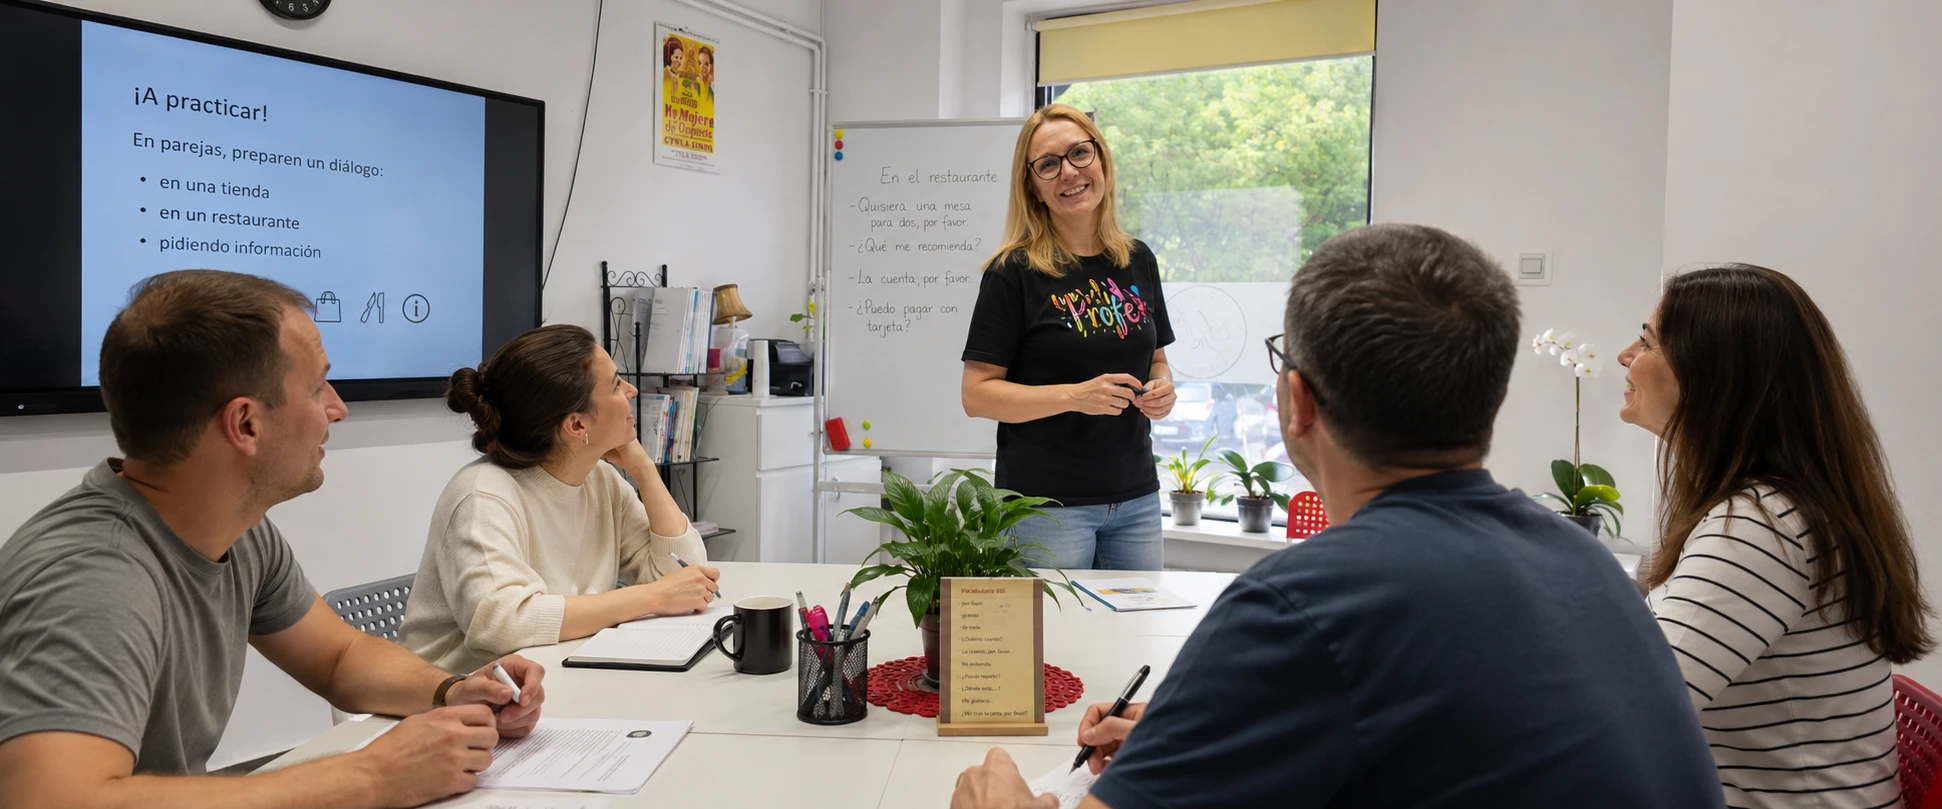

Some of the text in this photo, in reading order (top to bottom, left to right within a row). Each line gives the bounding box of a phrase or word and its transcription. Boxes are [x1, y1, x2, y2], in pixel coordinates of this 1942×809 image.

[134, 86, 268, 123] ¡A practicar!
[133, 131, 384, 179] En parejas, preparen un diálogo:
[880, 165, 998, 185] En el restaurante
[159, 177, 270, 199] en una tienda
[916, 202, 938, 212] una
[944, 202, 972, 212] mesa
[159, 208, 300, 230] en un restaurante
[870, 219, 894, 232] para
[899, 216, 920, 231] dos,
[923, 219, 939, 232] por
[159, 235, 321, 258] pidiendo información
[895, 243, 912, 252] me
[917, 237, 982, 252] recomienda?
[880, 271, 920, 287] cuenta,
[922, 275, 940, 288] por
[903, 305, 934, 320] pagar
[939, 305, 958, 314] con
[866, 318, 912, 339] tarjeta?
